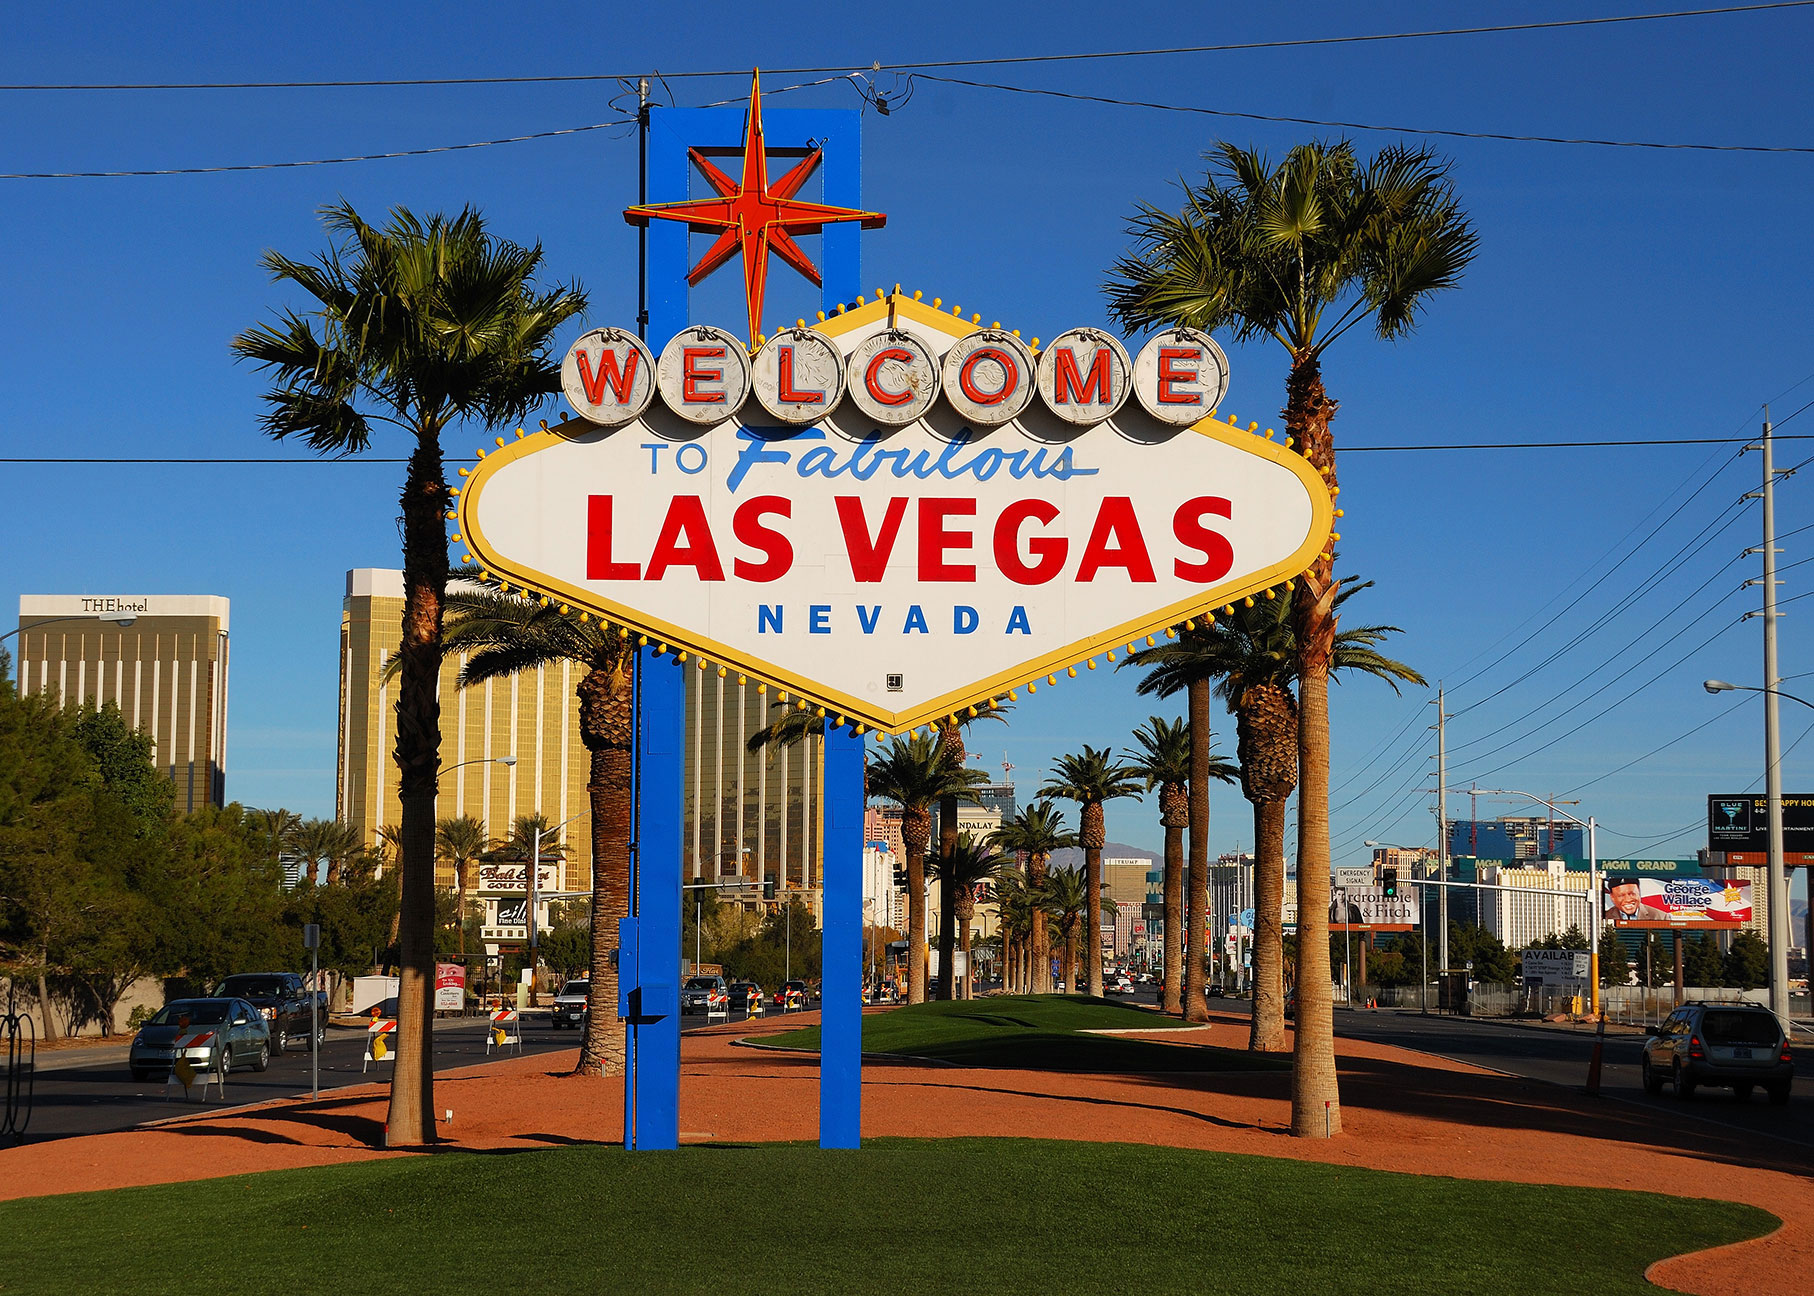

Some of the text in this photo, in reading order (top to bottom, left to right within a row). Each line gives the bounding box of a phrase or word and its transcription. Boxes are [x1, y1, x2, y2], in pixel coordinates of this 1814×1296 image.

[574, 346, 1203, 407] WELCOME
[640, 423, 1100, 494] TO Fabulous
[586, 495, 1235, 586] LAS VEGAS
[758, 604, 1032, 635] NEVADA
[1754, 799, 1767, 807] BES
[1780, 799, 1799, 807] APPY
[958, 821, 994, 830] NDALAY
[1474, 860, 1503, 869] MGM
[1601, 861, 1677, 870] MGM GRAND
[480, 866, 515, 880] Bali
[1339, 869, 1371, 877] EMERGENCY
[1345, 877, 1365, 885] SIGNAL
[1664, 883, 1710, 896] George
[1662, 894, 1712, 905] Wallace
[1362, 904, 1411, 918] & Fitch
[1524, 951, 1576, 961] AVAILAB
